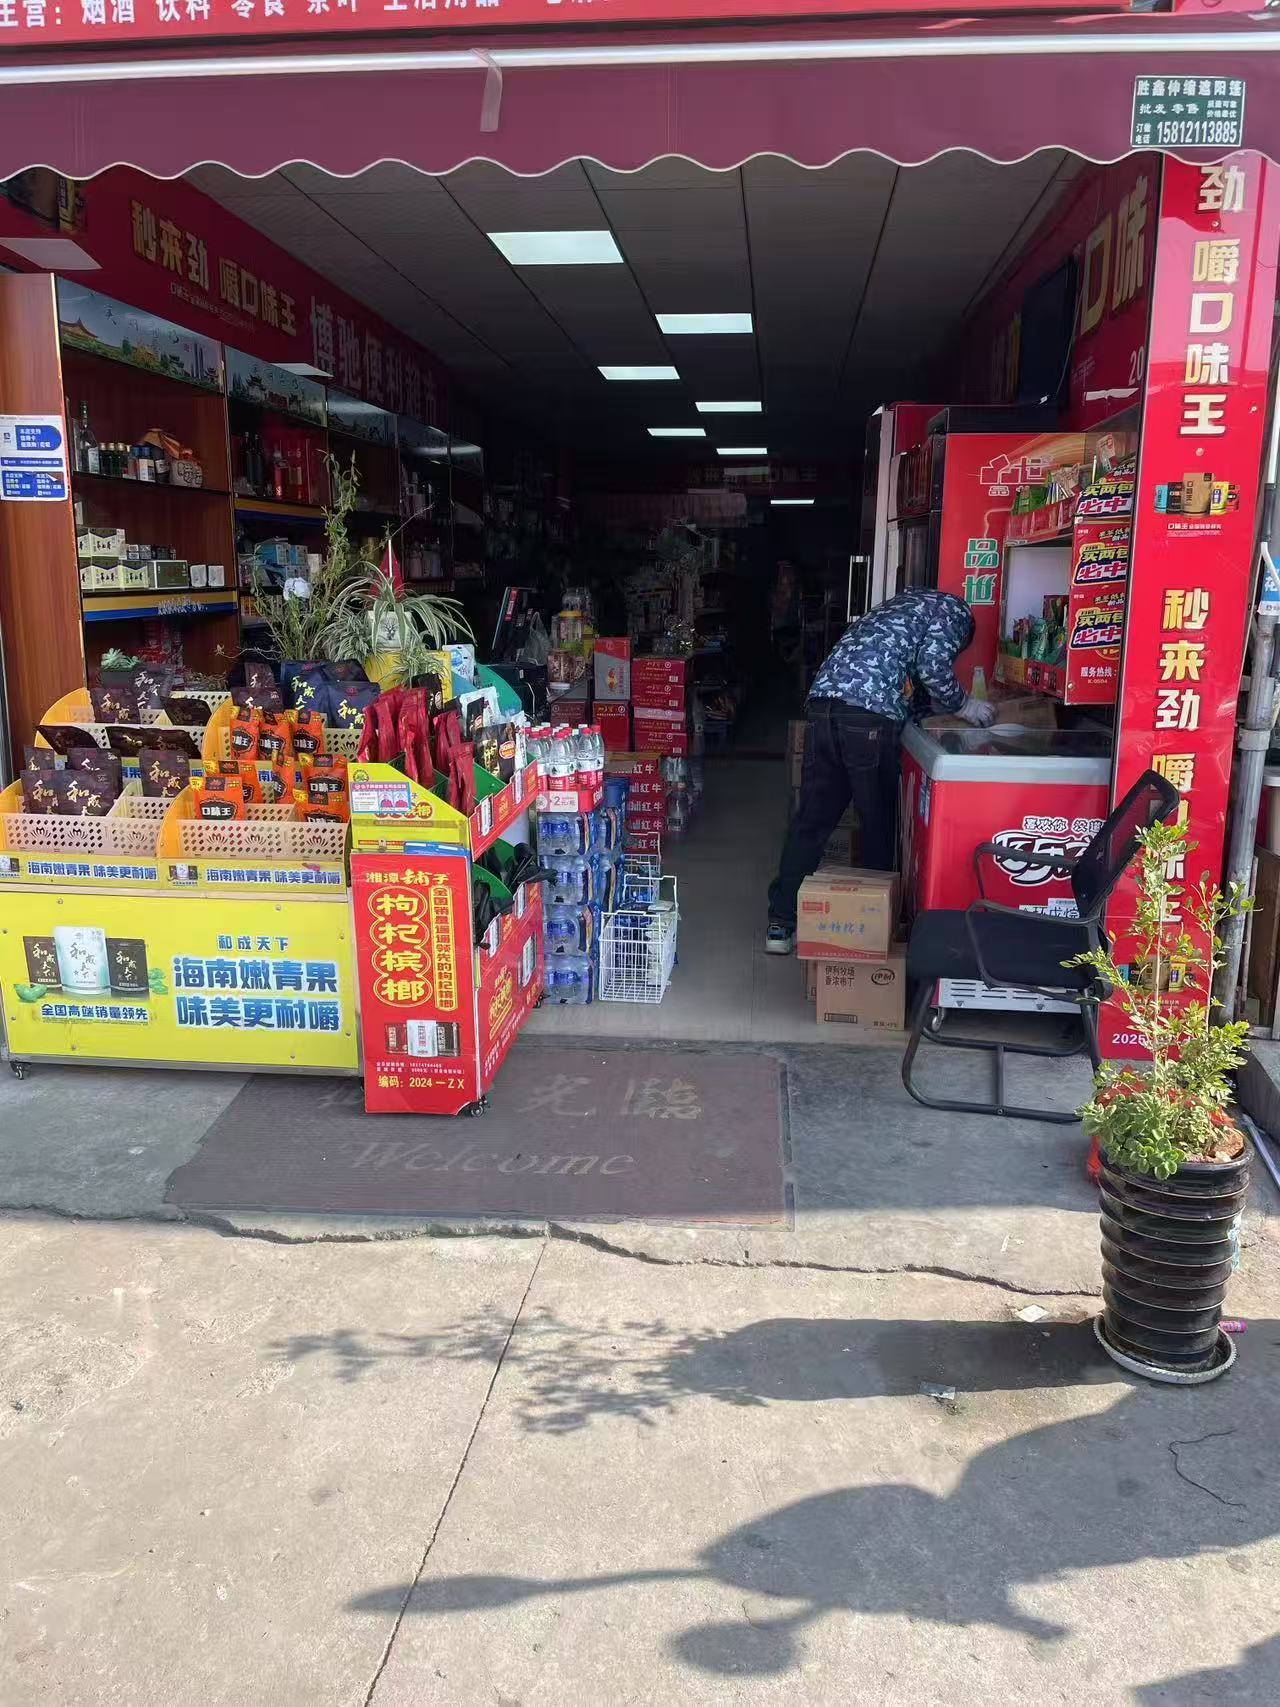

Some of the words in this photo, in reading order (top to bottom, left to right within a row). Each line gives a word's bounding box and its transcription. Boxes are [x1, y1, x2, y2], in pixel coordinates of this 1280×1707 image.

[1140, 103, 1166, 114] 批发
[1171, 103, 1199, 114] 零售
[1136, 134, 1150, 144] 电话
[1157, 121, 1238, 143] 15812113885
[1197, 165, 1245, 213] 劲
[130, 199, 209, 293] 秒来劲
[1179, 237, 1241, 436] 嚼口味王
[1154, 588, 1209, 732] 秒来劲
[201, 805, 232, 816] 口味王
[1024, 817, 1067, 832] 喜欢你
[28, 861, 90, 878] 海南嫩青果
[93, 863, 157, 881] 味美更耐嚼
[206, 868, 271, 883] 海南嫩青果
[217, 935, 290, 952] 和成天下
[376, 893, 425, 1002] 枸杞槟榔
[173, 957, 338, 993] 海南嫩青果
[41, 1004, 148, 1020] 全国高端销量领先
[176, 996, 340, 1032] 味美更耐嚼
[378, 1075, 404, 1088] 编码:
[338, 1141, 634, 1177] Welcome
